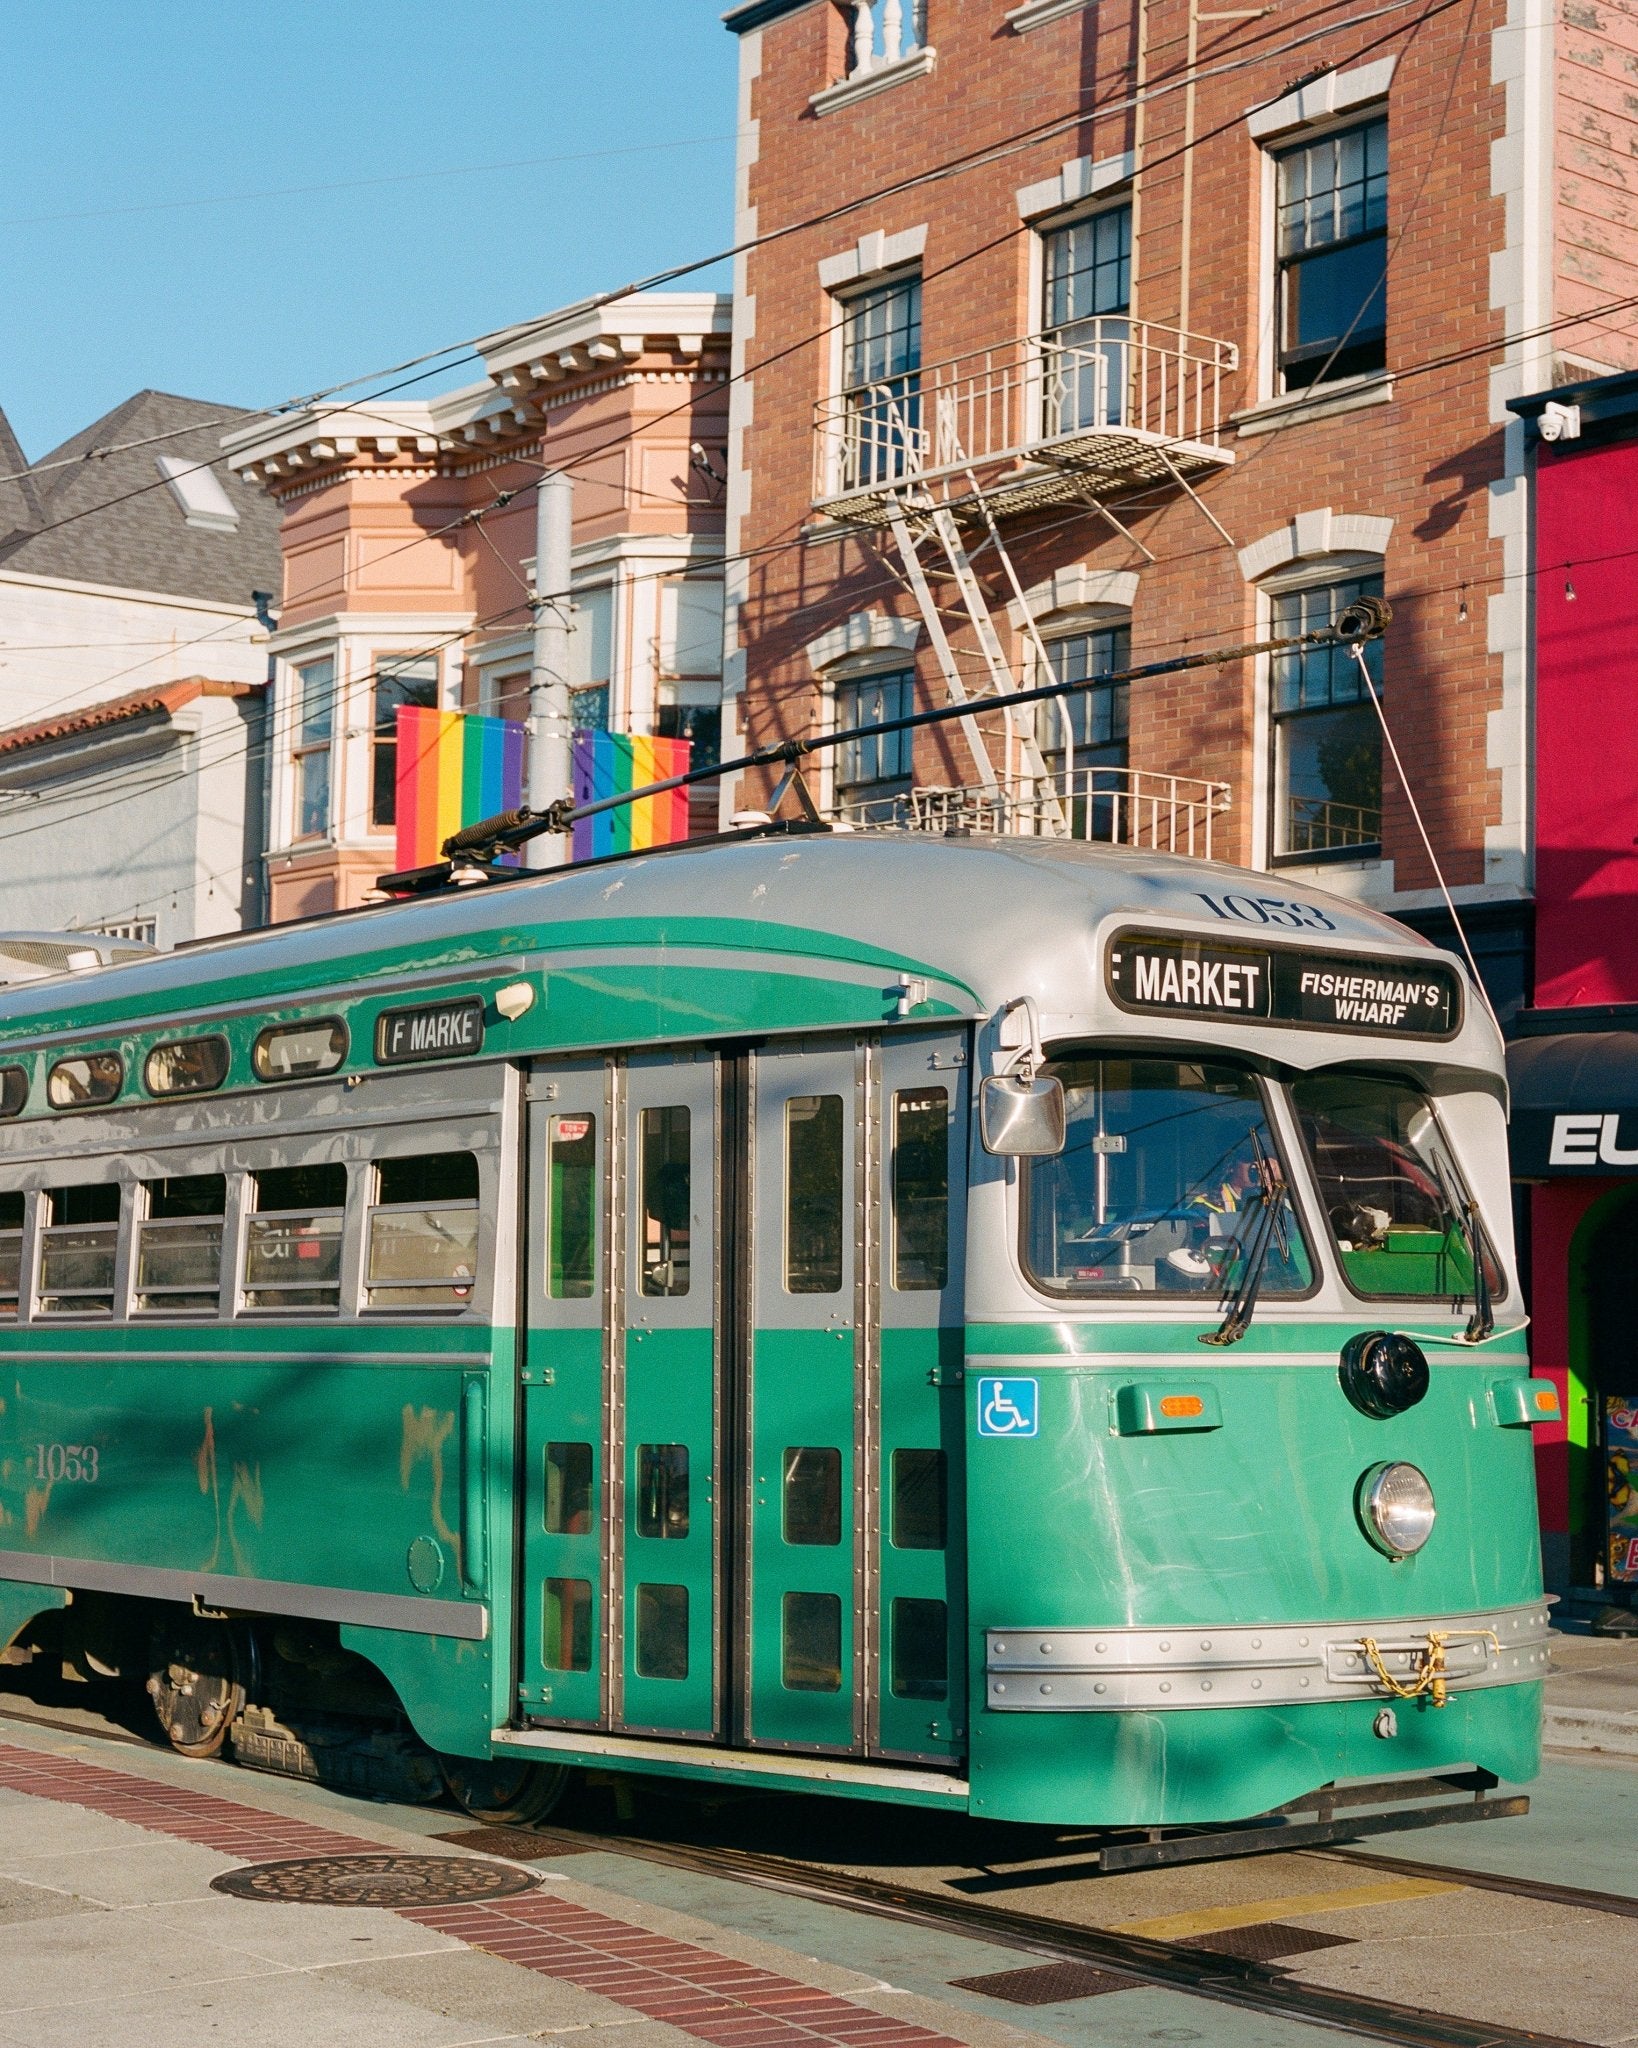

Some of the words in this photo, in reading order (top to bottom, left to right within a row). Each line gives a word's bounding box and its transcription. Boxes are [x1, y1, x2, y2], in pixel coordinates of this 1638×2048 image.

[1191, 893, 1336, 931] 1053
[1136, 955, 1260, 1009] MARKET
[1301, 972, 1440, 1007] FISHERMAN'S
[1335, 999, 1407, 1025] WHARF
[392, 1020, 406, 1053] F
[34, 1443, 99, 1483] 1053
